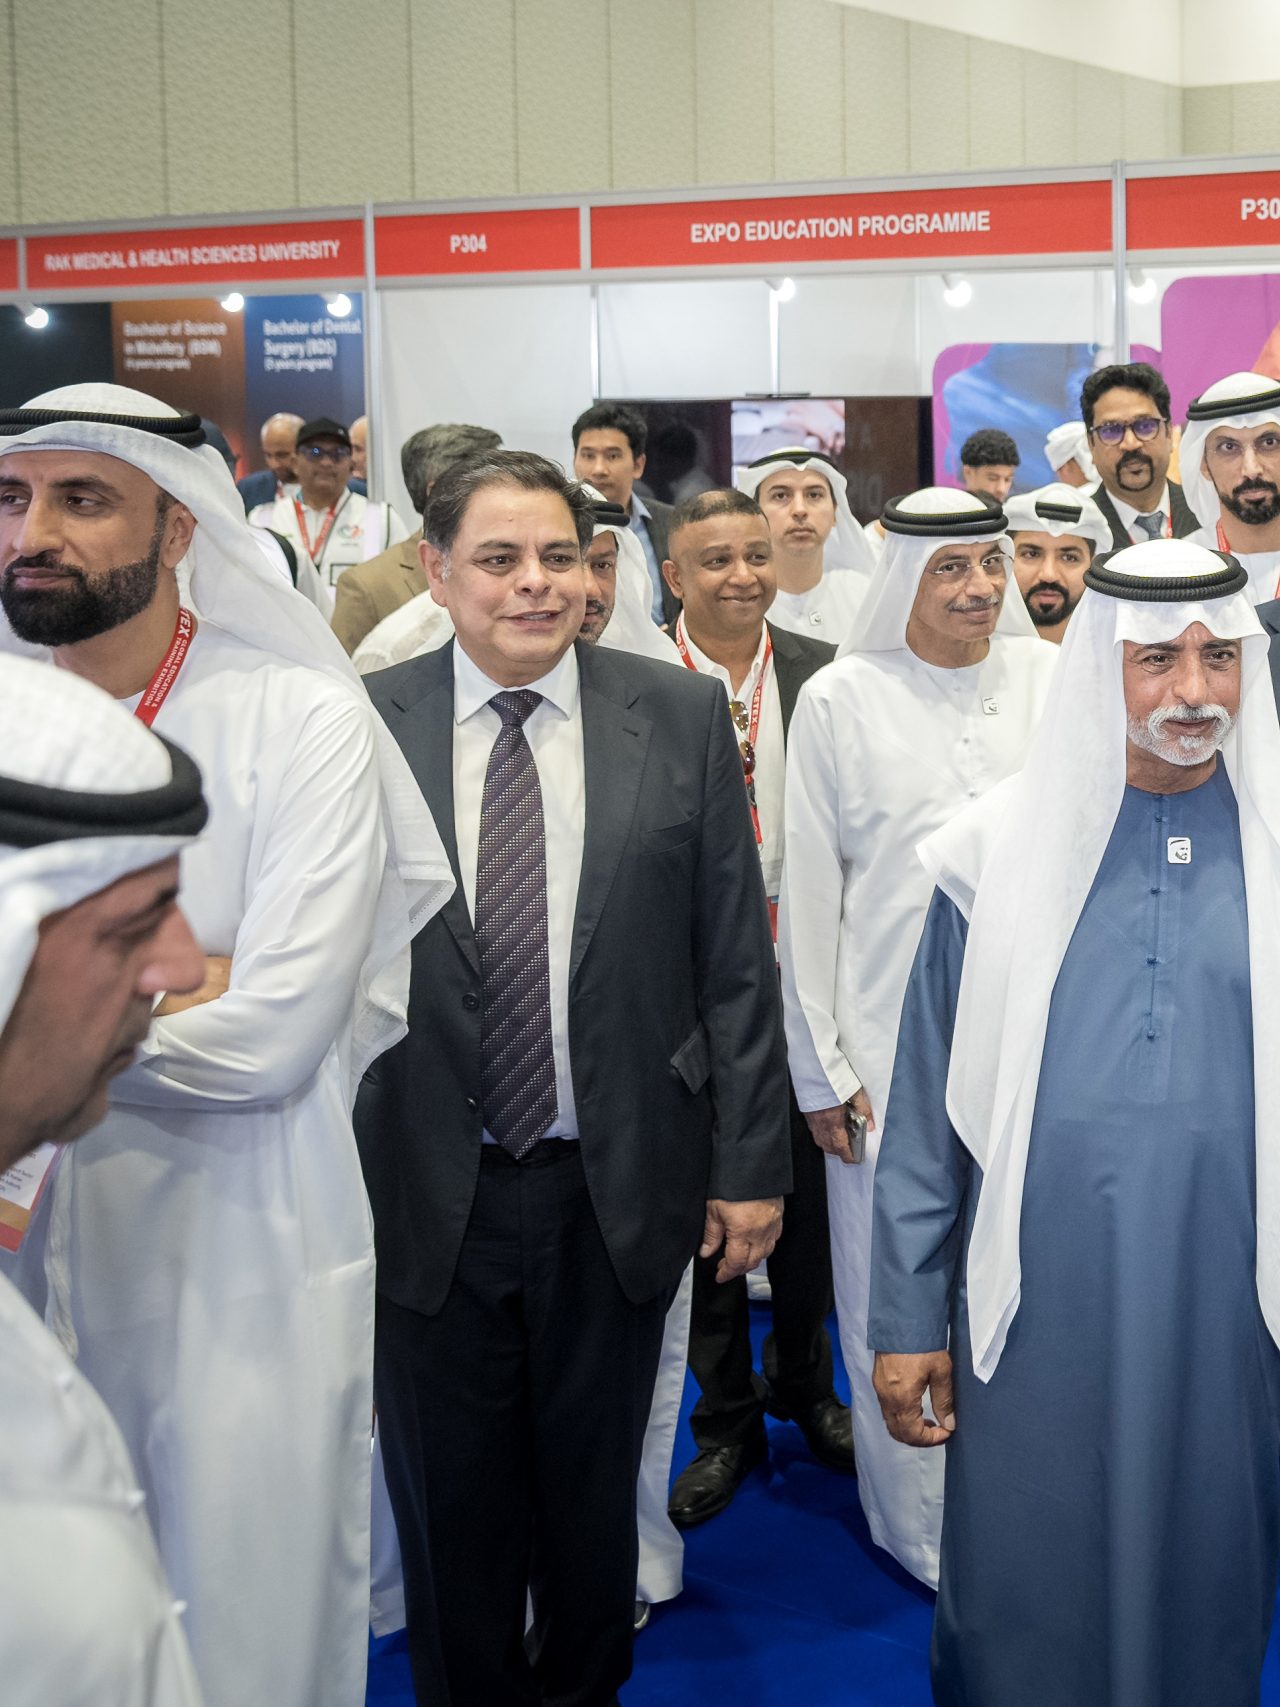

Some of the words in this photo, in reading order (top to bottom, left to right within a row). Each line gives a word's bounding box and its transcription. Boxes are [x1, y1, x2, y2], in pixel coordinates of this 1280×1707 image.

[690, 222, 740, 243] EXPO
[745, 217, 853, 241] EDUCATION
[858, 210, 991, 236] PROGRAMME
[44, 253, 71, 271] RAK
[72, 251, 127, 270] MEDICAL
[127, 250, 138, 268] &
[140, 247, 190, 267] HEALTH
[191, 243, 257, 265] SCIENCES
[258, 239, 340, 262] UNIVERSITY
[450, 233, 487, 254] P304
[263, 319, 309, 336] Bachelor
[310, 318, 323, 335] of
[164, 637, 181, 668] TRAINING
[176, 639, 188, 664] GLOBAL
[144, 667, 169, 707] EXHIBITION
[157, 665, 176, 702] EDUCATION
[751, 688, 761, 724] GETEX
